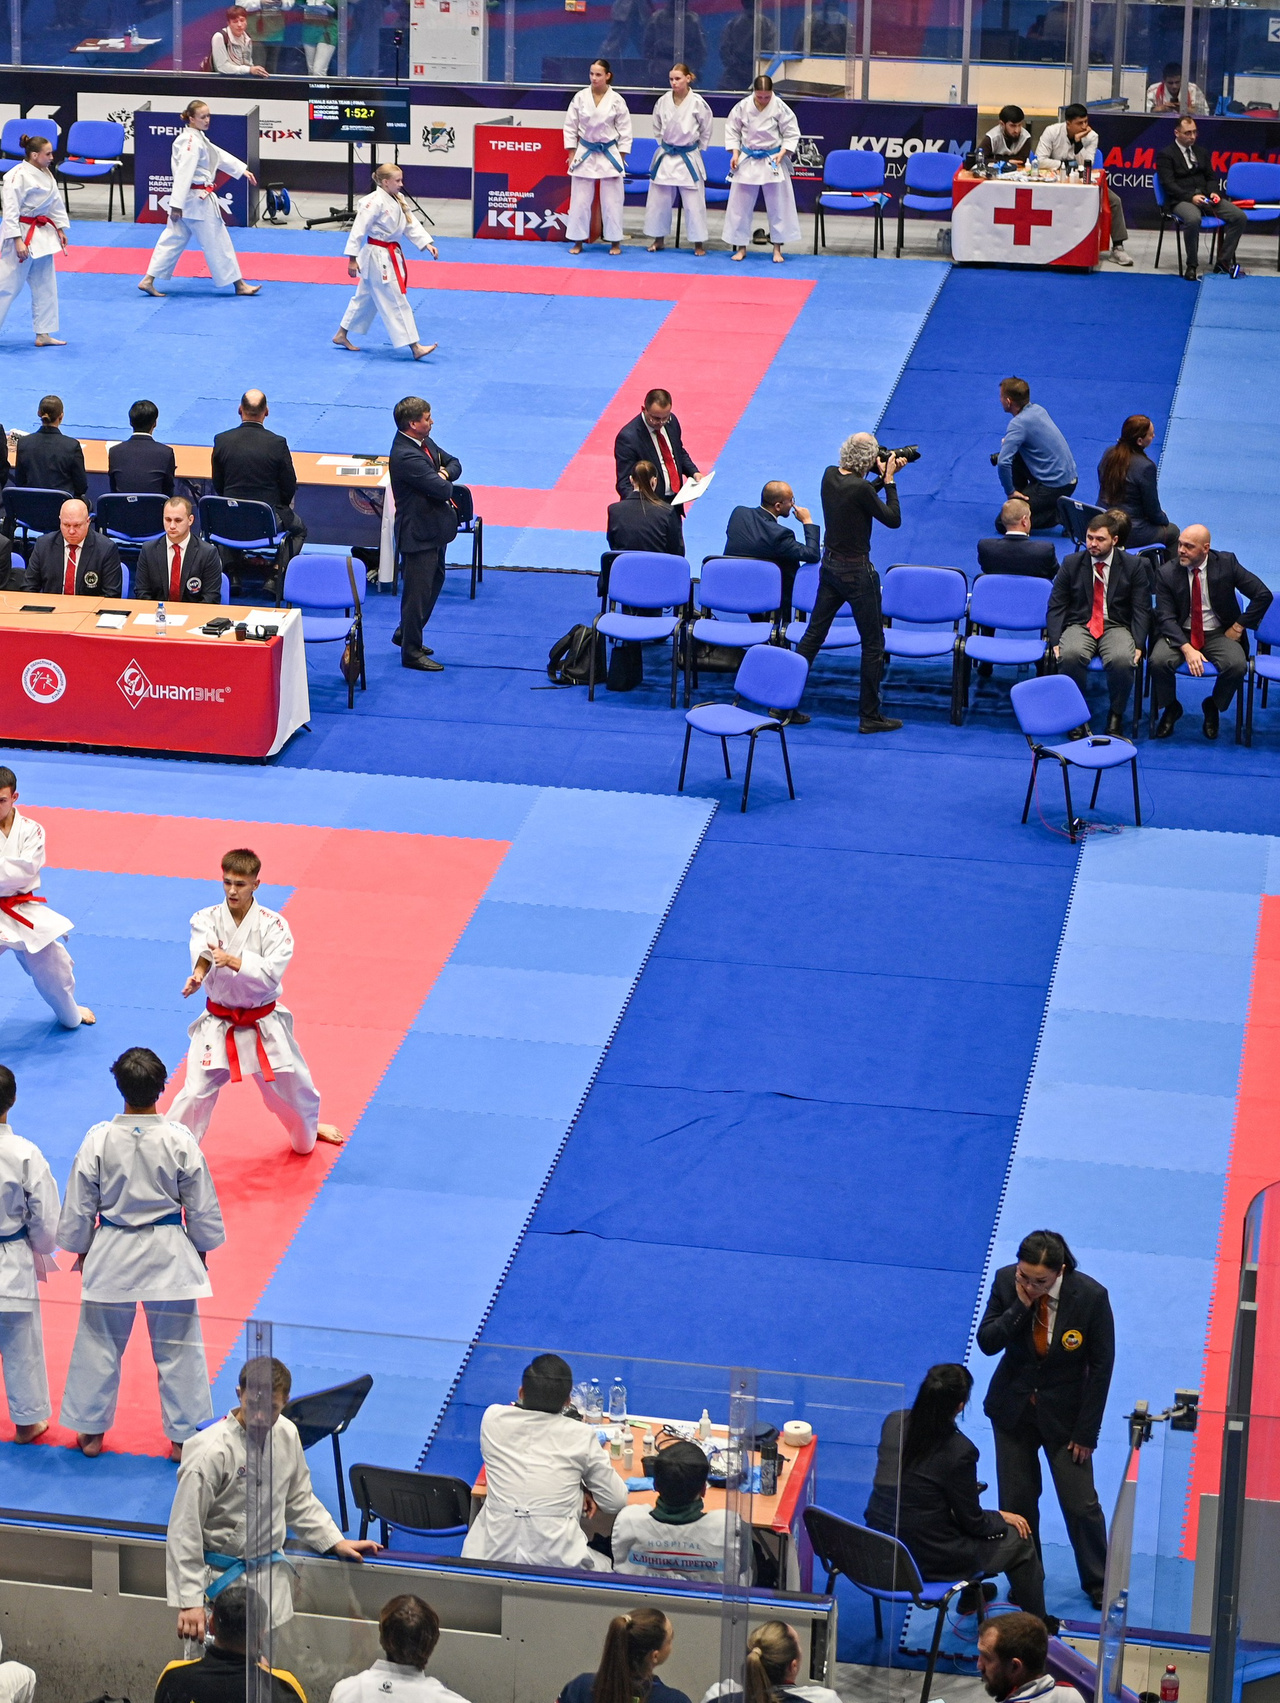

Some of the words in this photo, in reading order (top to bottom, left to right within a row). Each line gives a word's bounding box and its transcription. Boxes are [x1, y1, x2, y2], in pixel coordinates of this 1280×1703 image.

[344, 108, 376, 118] 1:52.7
[489, 140, 542, 152] ТРЕНЕР
[850, 136, 945, 159] КУБОК
[488, 190, 534, 198] ФЕДЕРАЦИЯ
[648, 1540, 701, 1550] HOSPITAL
[632, 1554, 680, 1568] КЛИНИКА
[681, 1558, 718, 1568] ПРЕТОР
